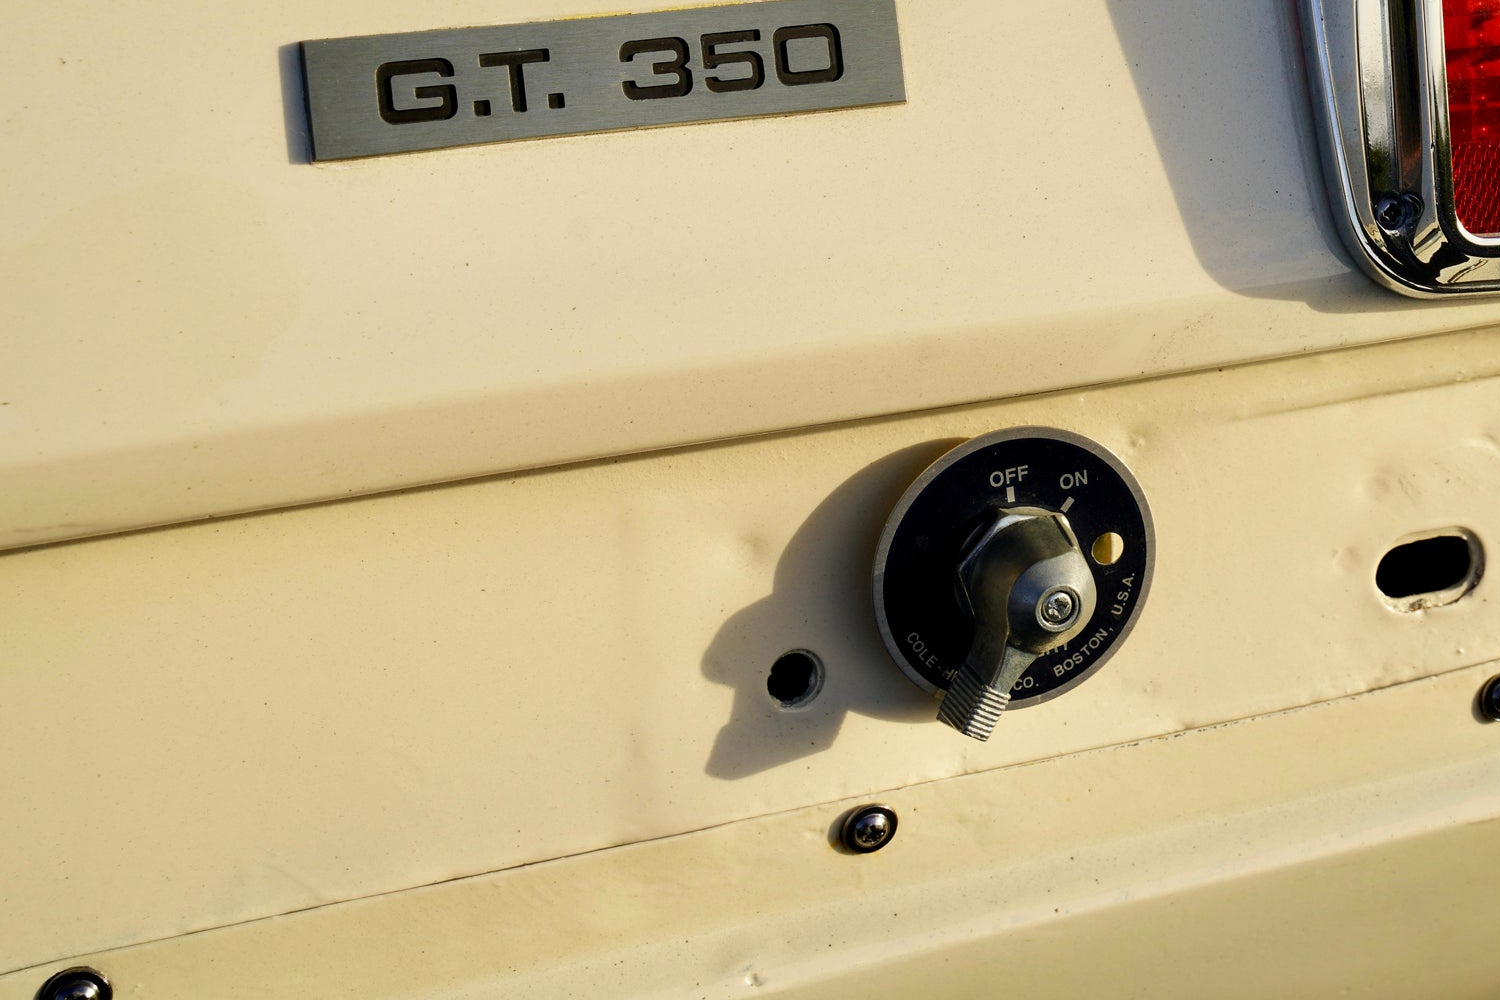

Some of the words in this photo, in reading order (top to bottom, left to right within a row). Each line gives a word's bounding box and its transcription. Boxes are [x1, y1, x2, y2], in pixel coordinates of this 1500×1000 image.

[374, 47, 566, 126] G.T.
[618, 22, 844, 101] 350
[989, 464, 1029, 488] OFF
[1059, 469, 1088, 490] ON
[1053, 627, 1115, 677] BOSTON,
[1111, 573, 1136, 615] U.S.A.
